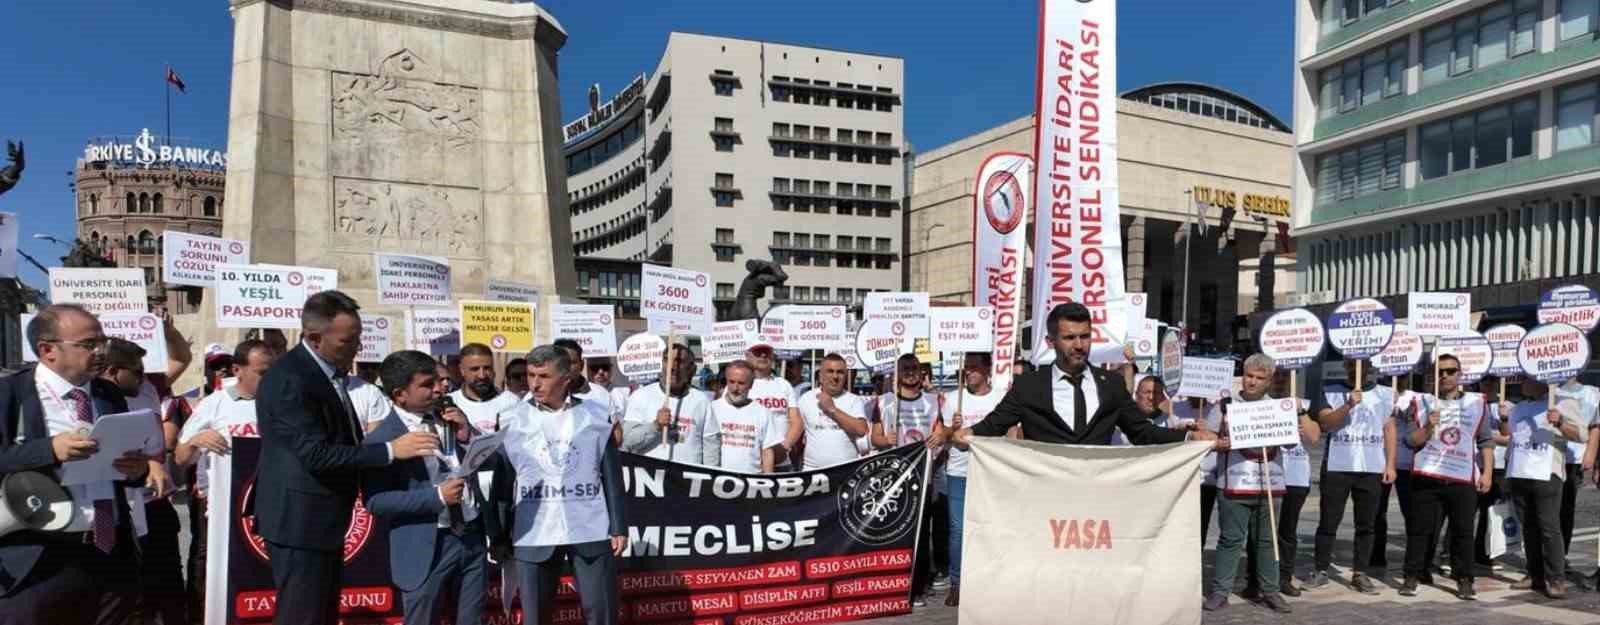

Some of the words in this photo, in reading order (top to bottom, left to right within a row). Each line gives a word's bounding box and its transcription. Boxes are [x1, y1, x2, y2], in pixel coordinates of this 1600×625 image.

[1051, 39, 1074, 128] İDARİ
[1075, 19, 1100, 181] SENDİKASI
[1193, 184, 1237, 209] ULUS
[1046, 135, 1073, 311] ÜNİVERSİTE
[186, 239, 222, 252] TAYİN
[180, 251, 228, 264] SORUNU
[1079, 189, 1109, 344] PERSONEL
[54, 278, 114, 288] ÜNİVERSİTE
[115, 278, 143, 287] İDARİ
[221, 271, 240, 281] 10.
[242, 271, 281, 284] YILDA
[72, 289, 128, 299] PERSONELİ
[238, 286, 284, 301] YEŞİL
[383, 291, 410, 300] SAHİP
[657, 284, 690, 299] 3600
[222, 304, 304, 318] PASAPORT
[463, 305, 505, 314] MEMURUN
[505, 306, 531, 315] TORBA
[644, 301, 657, 310] EK
[657, 301, 704, 316] GÖSTERGE
[996, 247, 1017, 375] SENDİKASI
[471, 315, 500, 323] YASASI
[500, 315, 525, 324] ARTIK
[799, 320, 827, 330] 3600
[129, 332, 153, 341] ZAM
[466, 324, 498, 333] MECLİSE
[500, 324, 530, 334] GELSİN
[801, 332, 840, 341] GÖSTERGE
[1526, 342, 1579, 361] MAAŞLARI
[520, 482, 600, 499] BİZİM-SEN
[682, 470, 831, 500] TORBA
[622, 515, 819, 557] MECLİSE
[1048, 519, 1113, 549] YASA
[810, 563, 841, 574] 5510
[842, 556, 878, 571] SAYILI
[622, 574, 693, 589] EMEKLİYE
[694, 568, 765, 585] SEYYANEN
[767, 565, 797, 578] ZAM
[834, 580, 865, 595] YEŞİL
[743, 589, 798, 606] DİSİPLİN
[801, 587, 825, 599] AFFI
[637, 600, 688, 617] MAKTU
[691, 593, 734, 611] MESAİ
[739, 606, 843, 625] YÜKSEKÖĞRETİM
